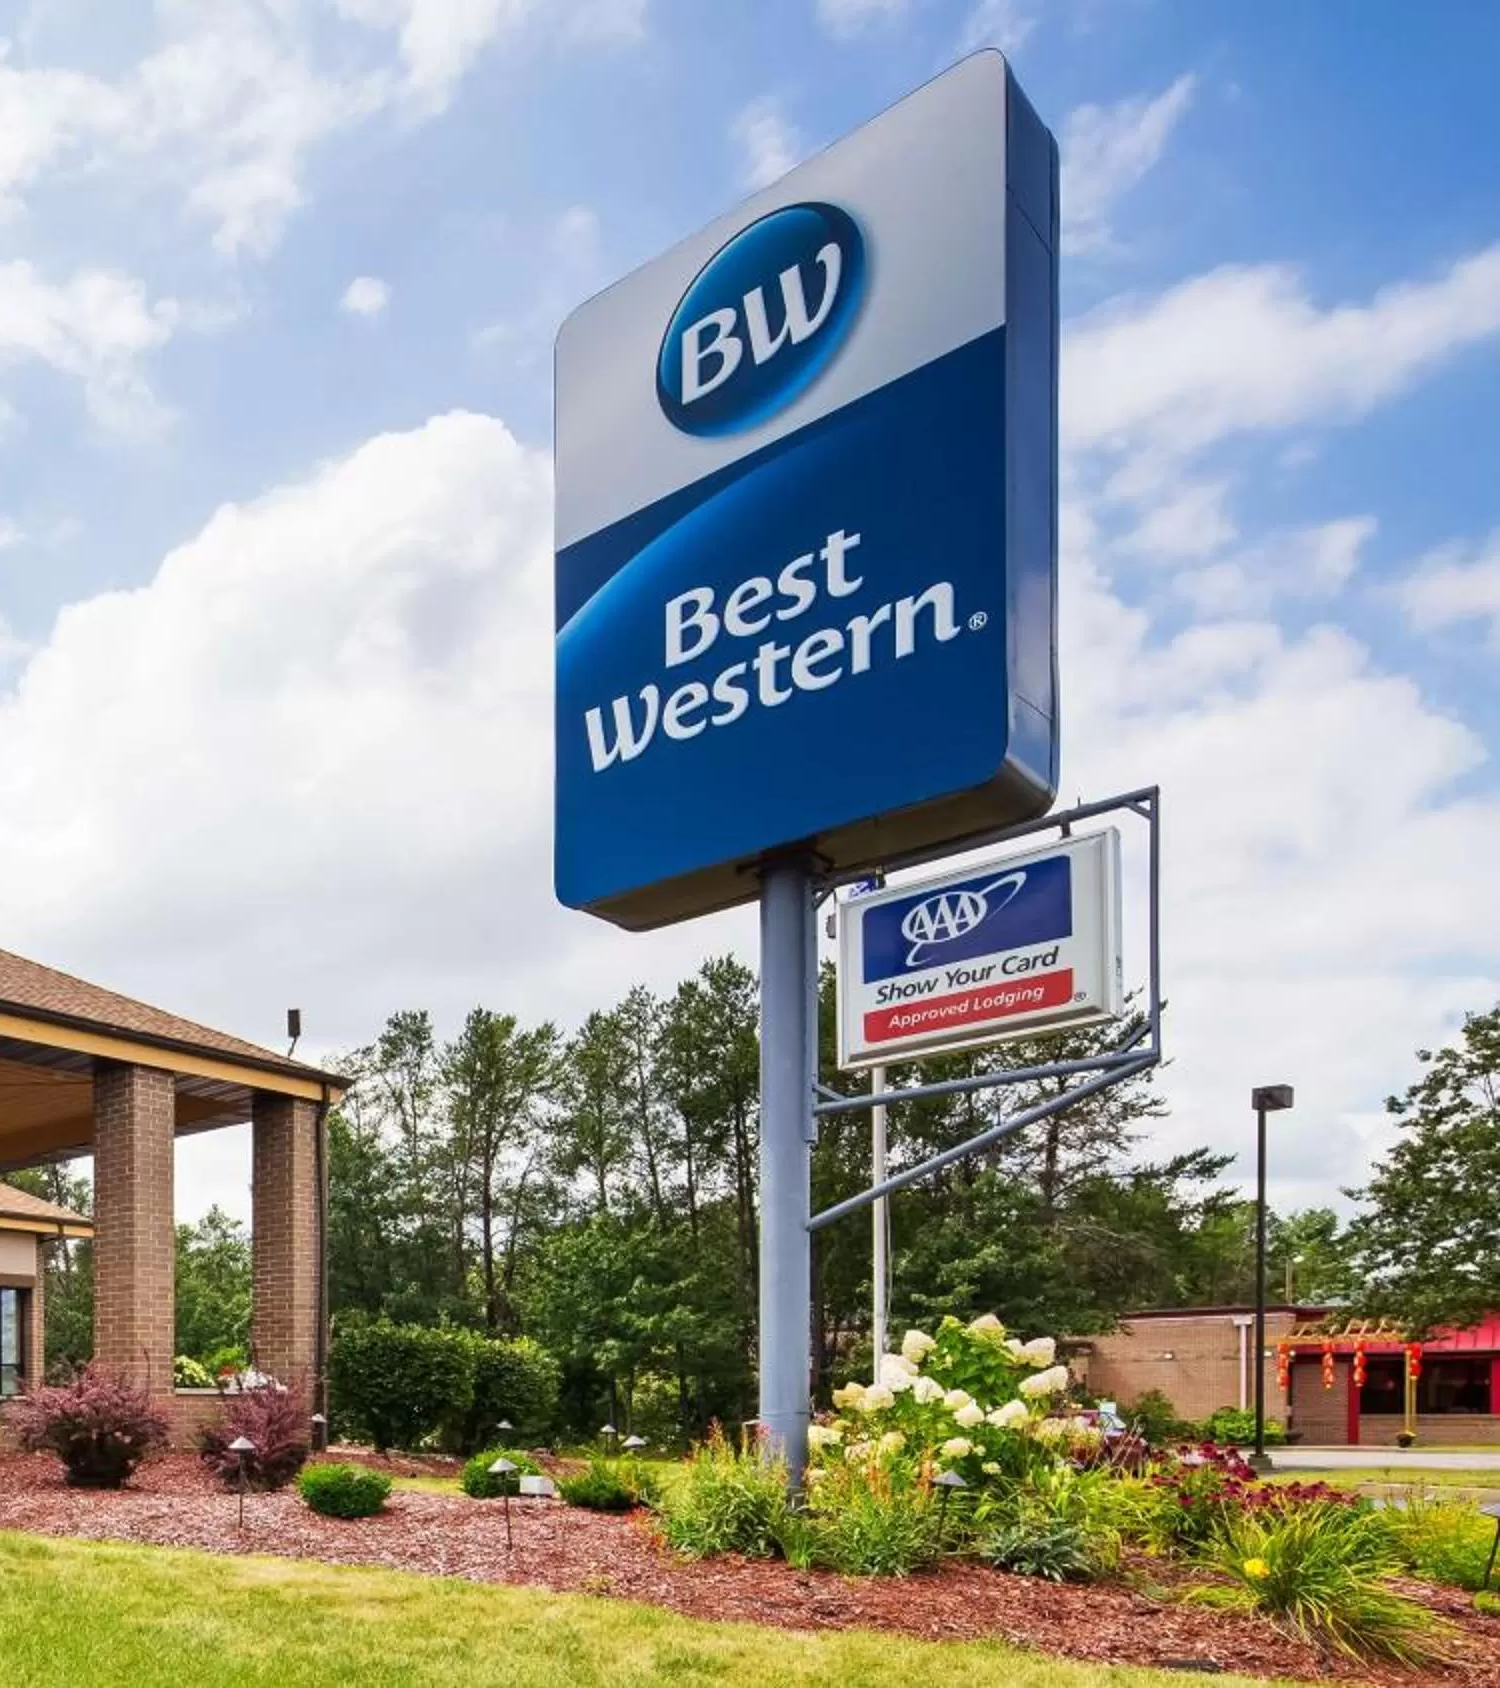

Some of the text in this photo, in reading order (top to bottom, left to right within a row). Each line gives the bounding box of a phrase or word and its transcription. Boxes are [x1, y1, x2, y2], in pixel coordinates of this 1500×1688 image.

[681, 243, 841, 405] BW
[664, 529, 863, 668] Best
[584, 581, 961, 772] Western
[911, 893, 978, 941] AAA
[875, 946, 1060, 1005] Show Your Card
[888, 985, 1045, 1029] Approved Lodging
